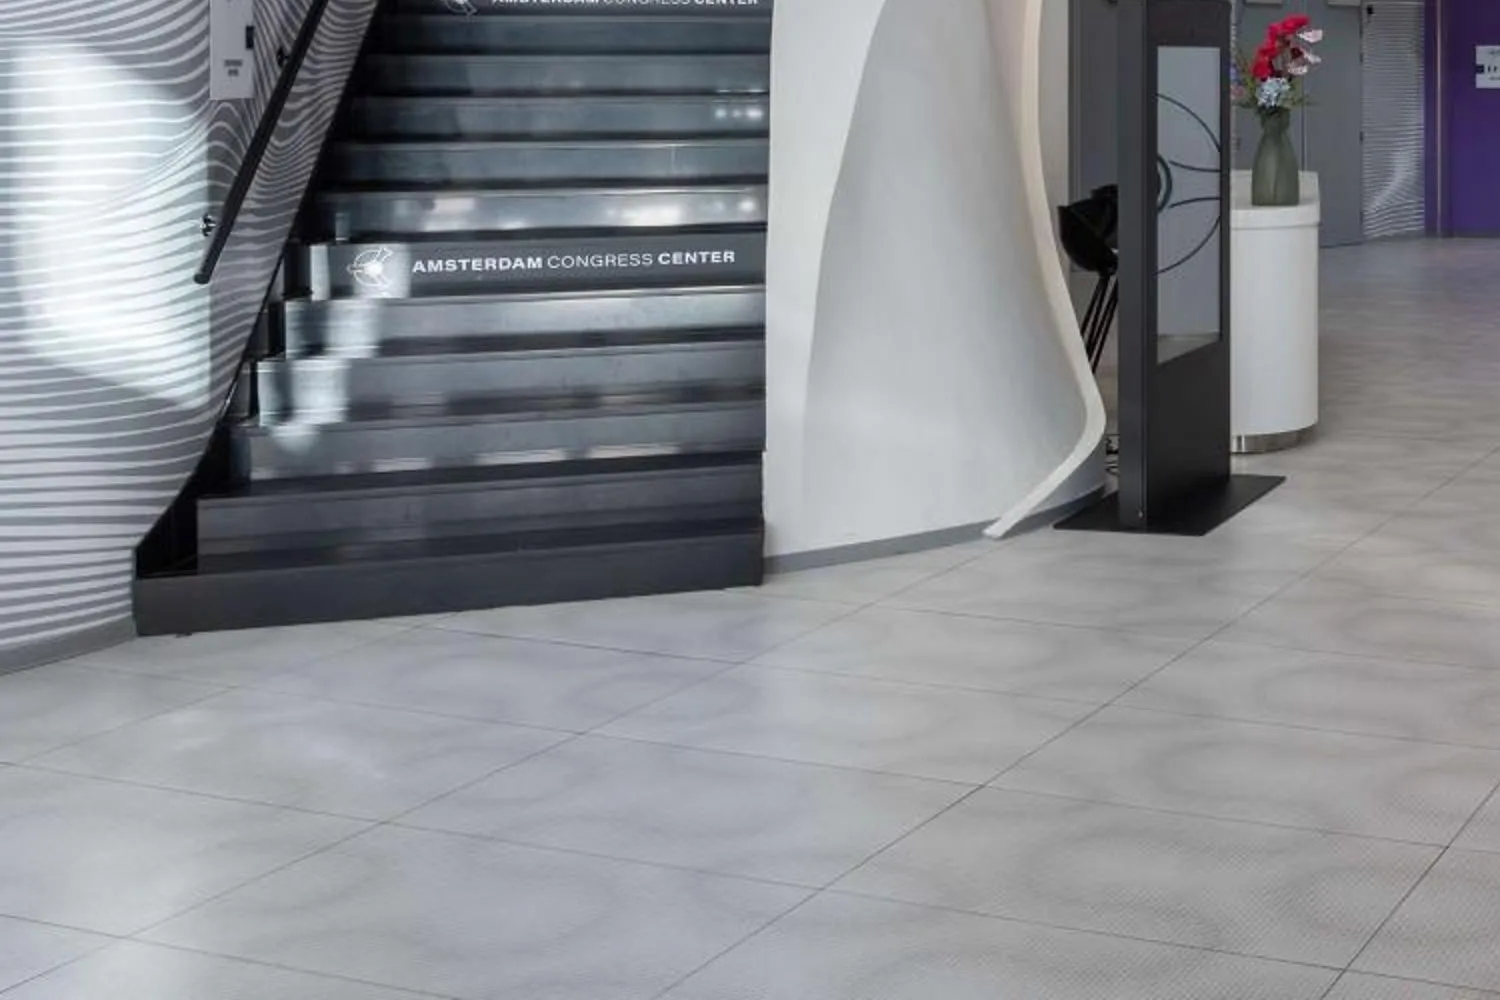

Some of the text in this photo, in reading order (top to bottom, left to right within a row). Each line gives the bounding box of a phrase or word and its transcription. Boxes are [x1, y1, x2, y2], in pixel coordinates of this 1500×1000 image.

[411, 250, 736, 274] AMSTERDAM CONGRESS CENTER
